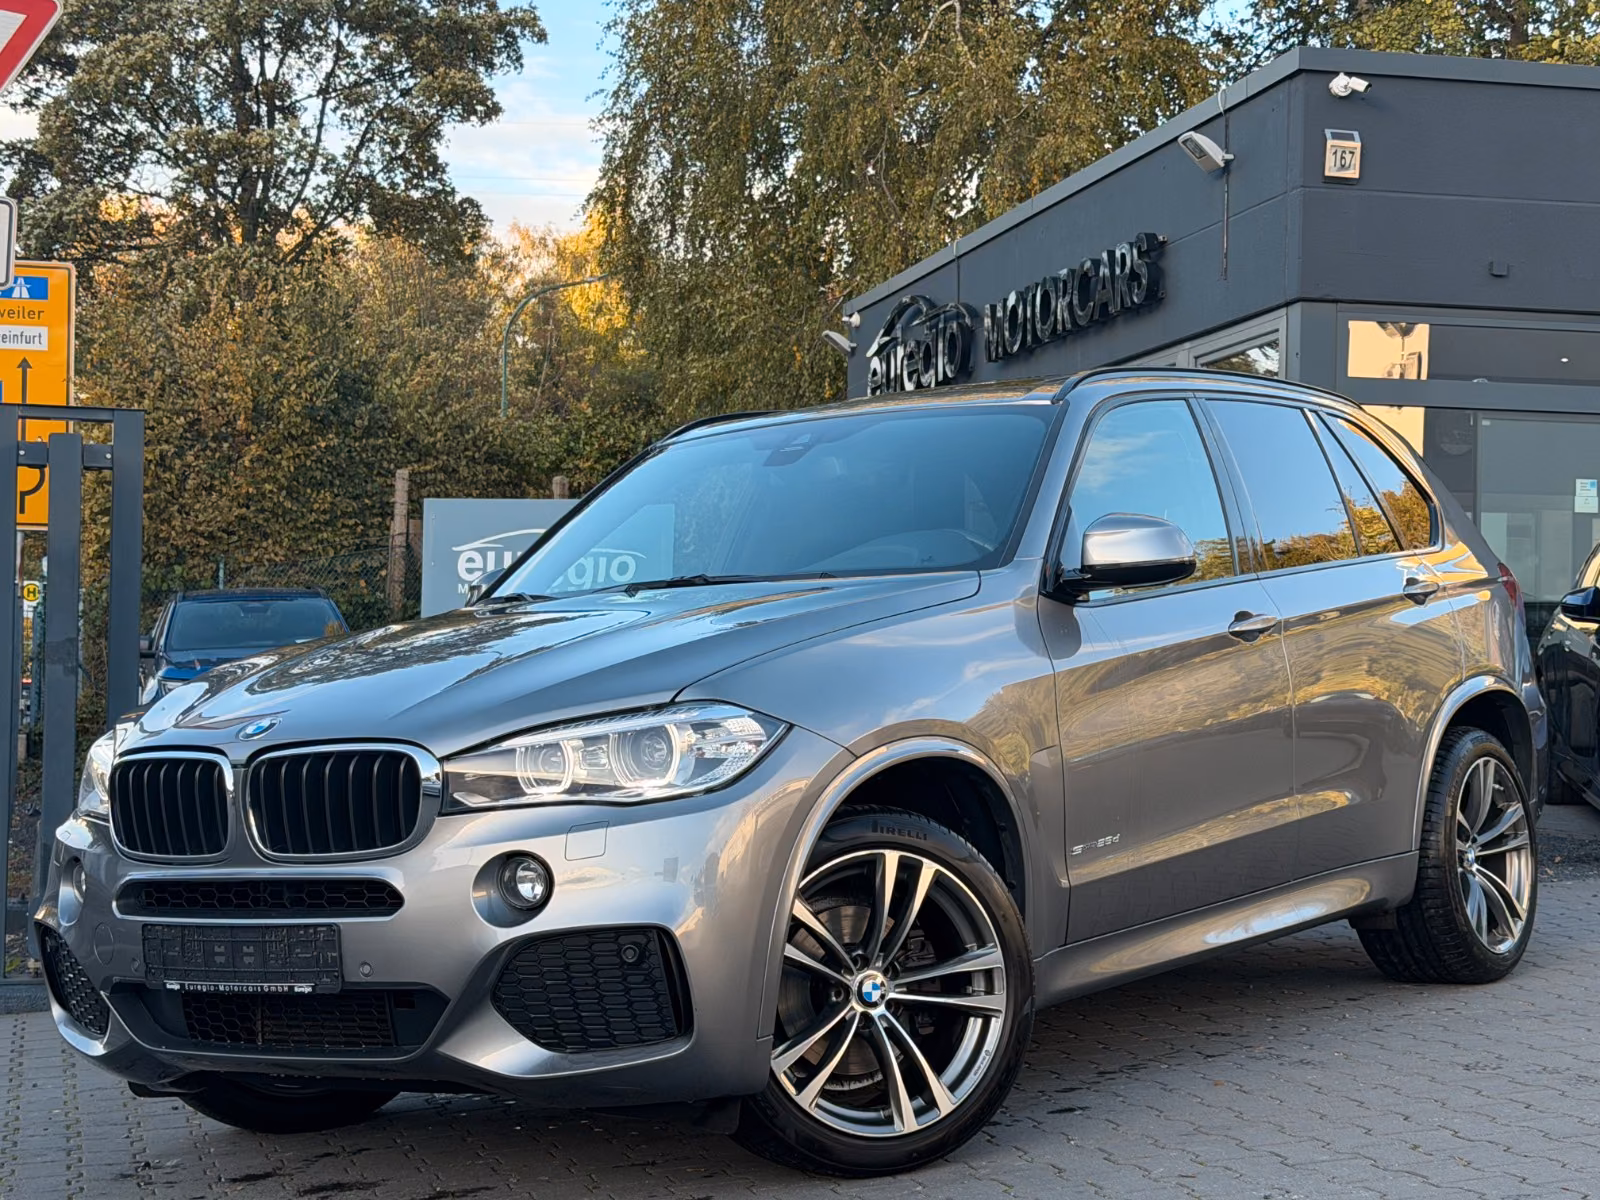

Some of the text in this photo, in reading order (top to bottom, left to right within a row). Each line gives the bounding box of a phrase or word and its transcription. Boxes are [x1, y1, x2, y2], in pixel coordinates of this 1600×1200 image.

[1332, 148, 1356, 169] 167
[984, 232, 1156, 363] MOTORCARS
[0, 330, 42, 345] einfurt
[871, 819, 928, 841] PIRELLI
